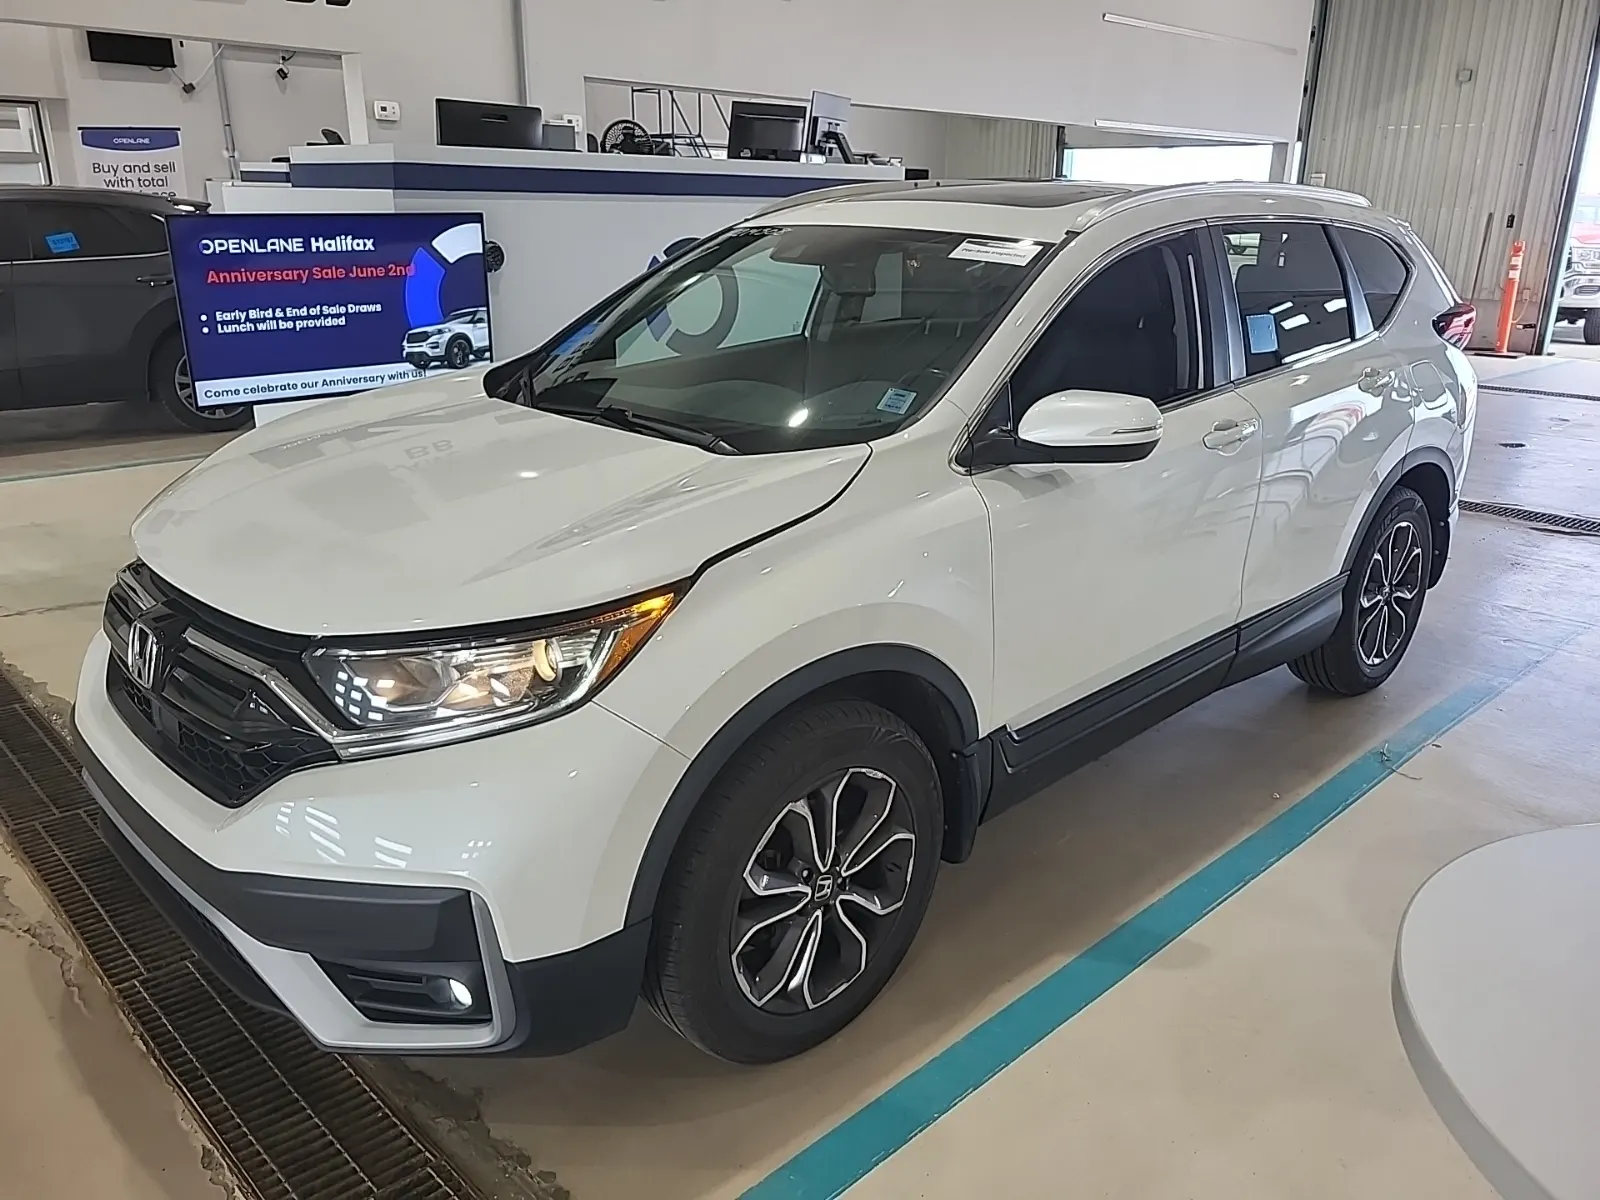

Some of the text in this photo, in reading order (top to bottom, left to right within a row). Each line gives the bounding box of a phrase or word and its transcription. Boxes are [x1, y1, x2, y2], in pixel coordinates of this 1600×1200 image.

[92, 161, 176, 177] Buy and sell
[103, 176, 168, 188] with total
[199, 235, 375, 254] OPENLANE Halifax
[207, 263, 415, 284] Anniversary Sale June 2nd
[215, 303, 382, 322] Early Bird & End of Sale Draws
[217, 315, 346, 334] Lunch will be provided
[204, 368, 427, 399] Come celebrate our Anniversary with us!
